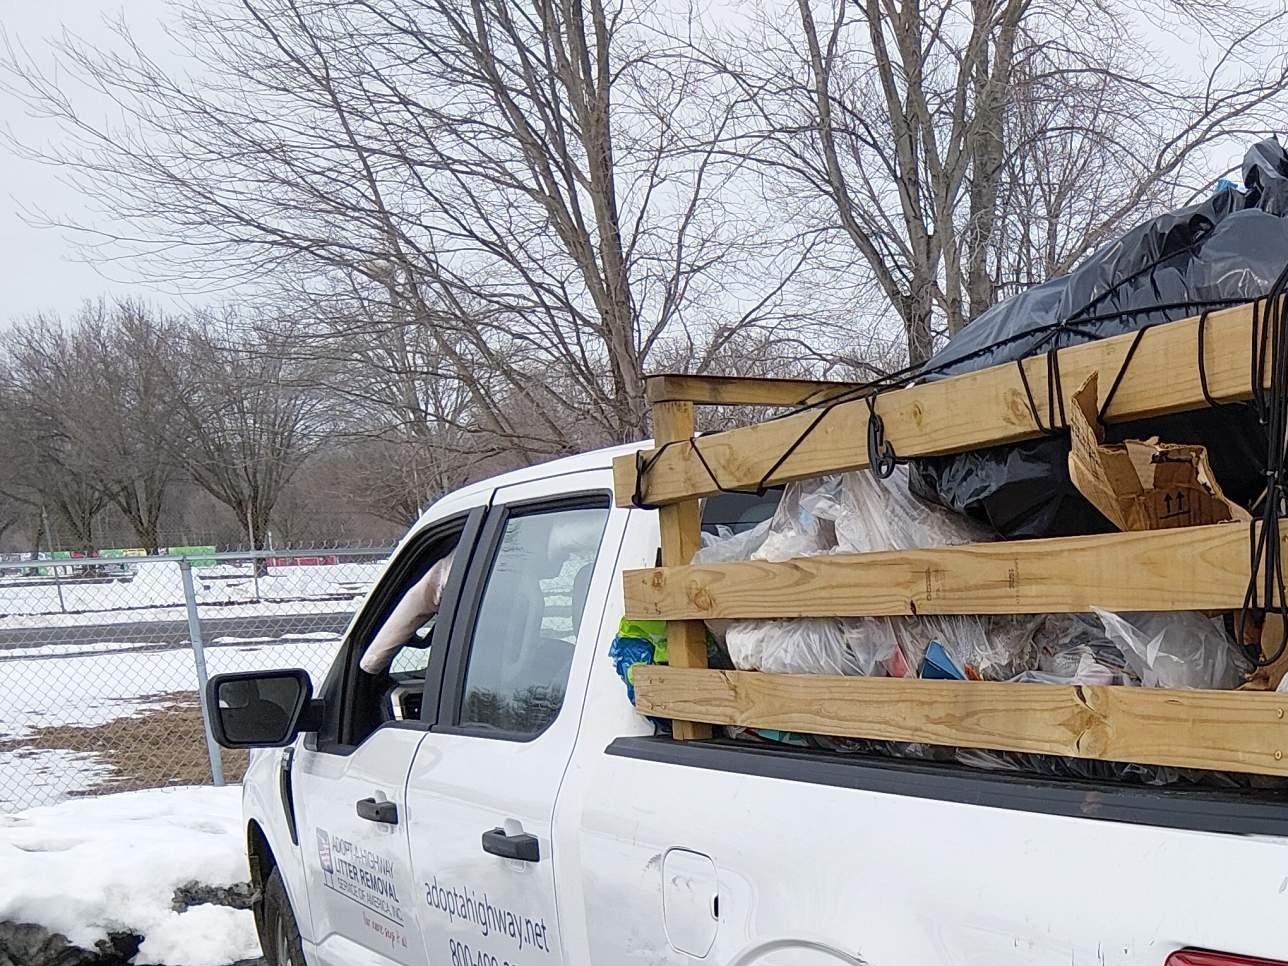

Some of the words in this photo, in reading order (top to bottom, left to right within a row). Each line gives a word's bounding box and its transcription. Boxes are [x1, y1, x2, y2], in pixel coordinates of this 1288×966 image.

[335, 856, 360, 885] LITTER
[359, 868, 400, 904] REMOVAL
[424, 876, 550, 952] adoptahighway.net
